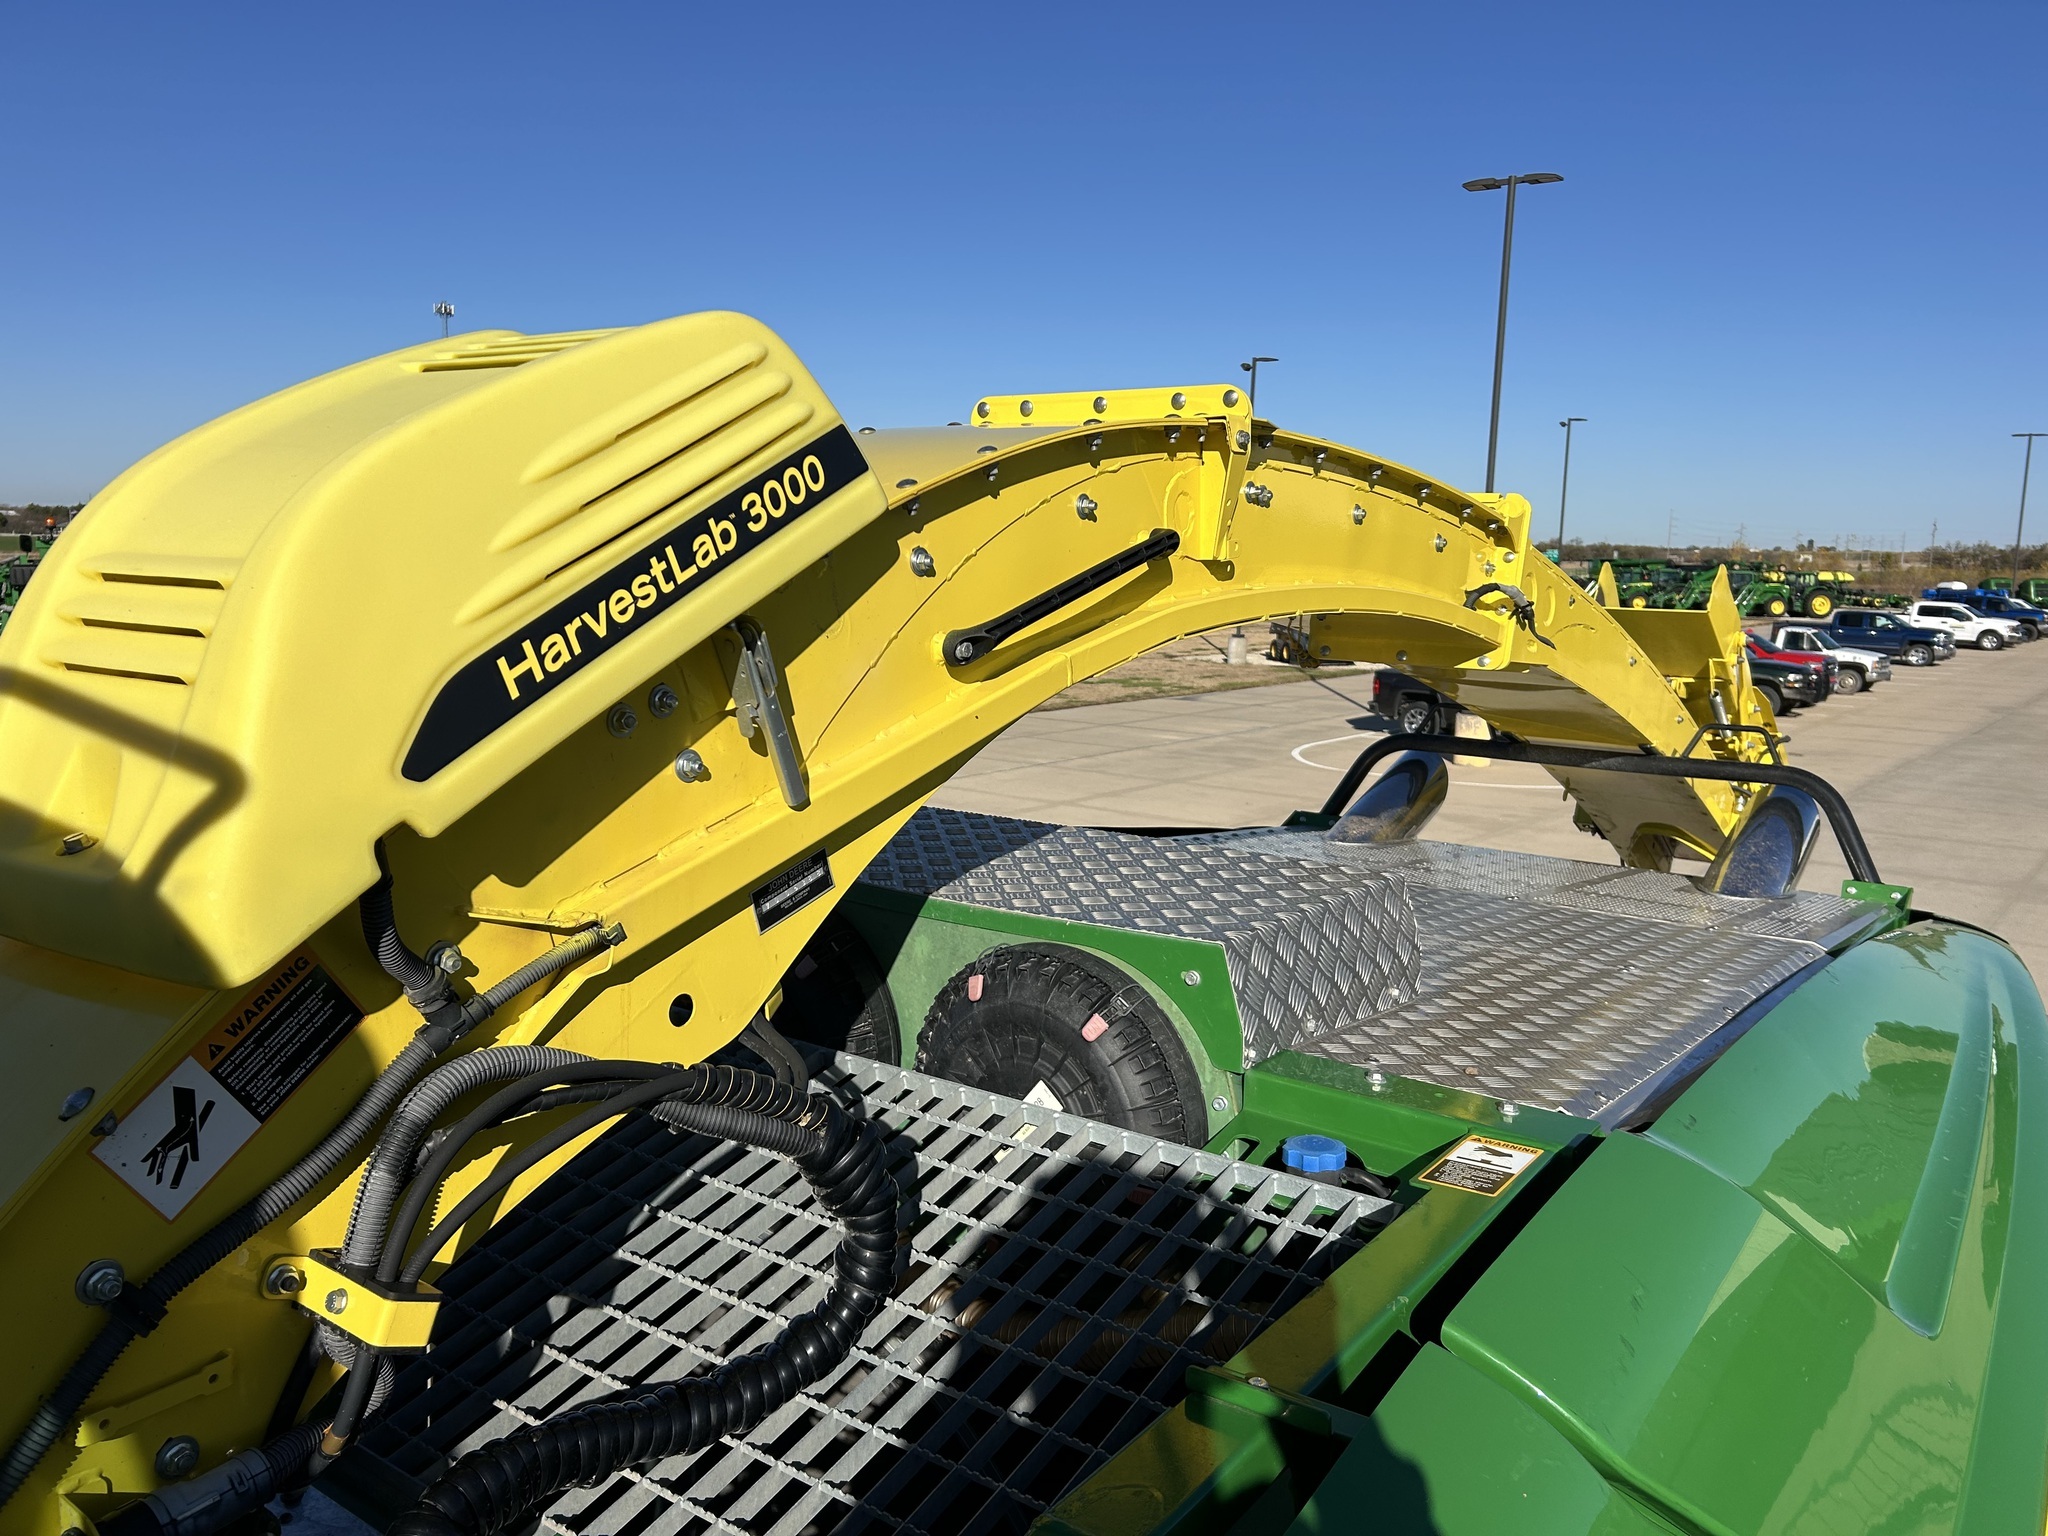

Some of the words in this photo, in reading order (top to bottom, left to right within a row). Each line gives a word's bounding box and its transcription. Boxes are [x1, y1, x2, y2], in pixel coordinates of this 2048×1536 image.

[741, 454, 826, 532] 3000
[769, 875, 788, 892] JOHN
[789, 858, 813, 878] DEERE
[224, 956, 310, 1038] WARNING
[218, 1060, 231, 1073] Avoid
[230, 1047, 244, 1061] bodily
[260, 1020, 271, 1031] from
[271, 1000, 291, 1020] hydraulic
[279, 1083, 292, 1096] JOHN
[291, 1068, 306, 1083] DEERE
[1484, 1139, 1539, 1155] WARNING
